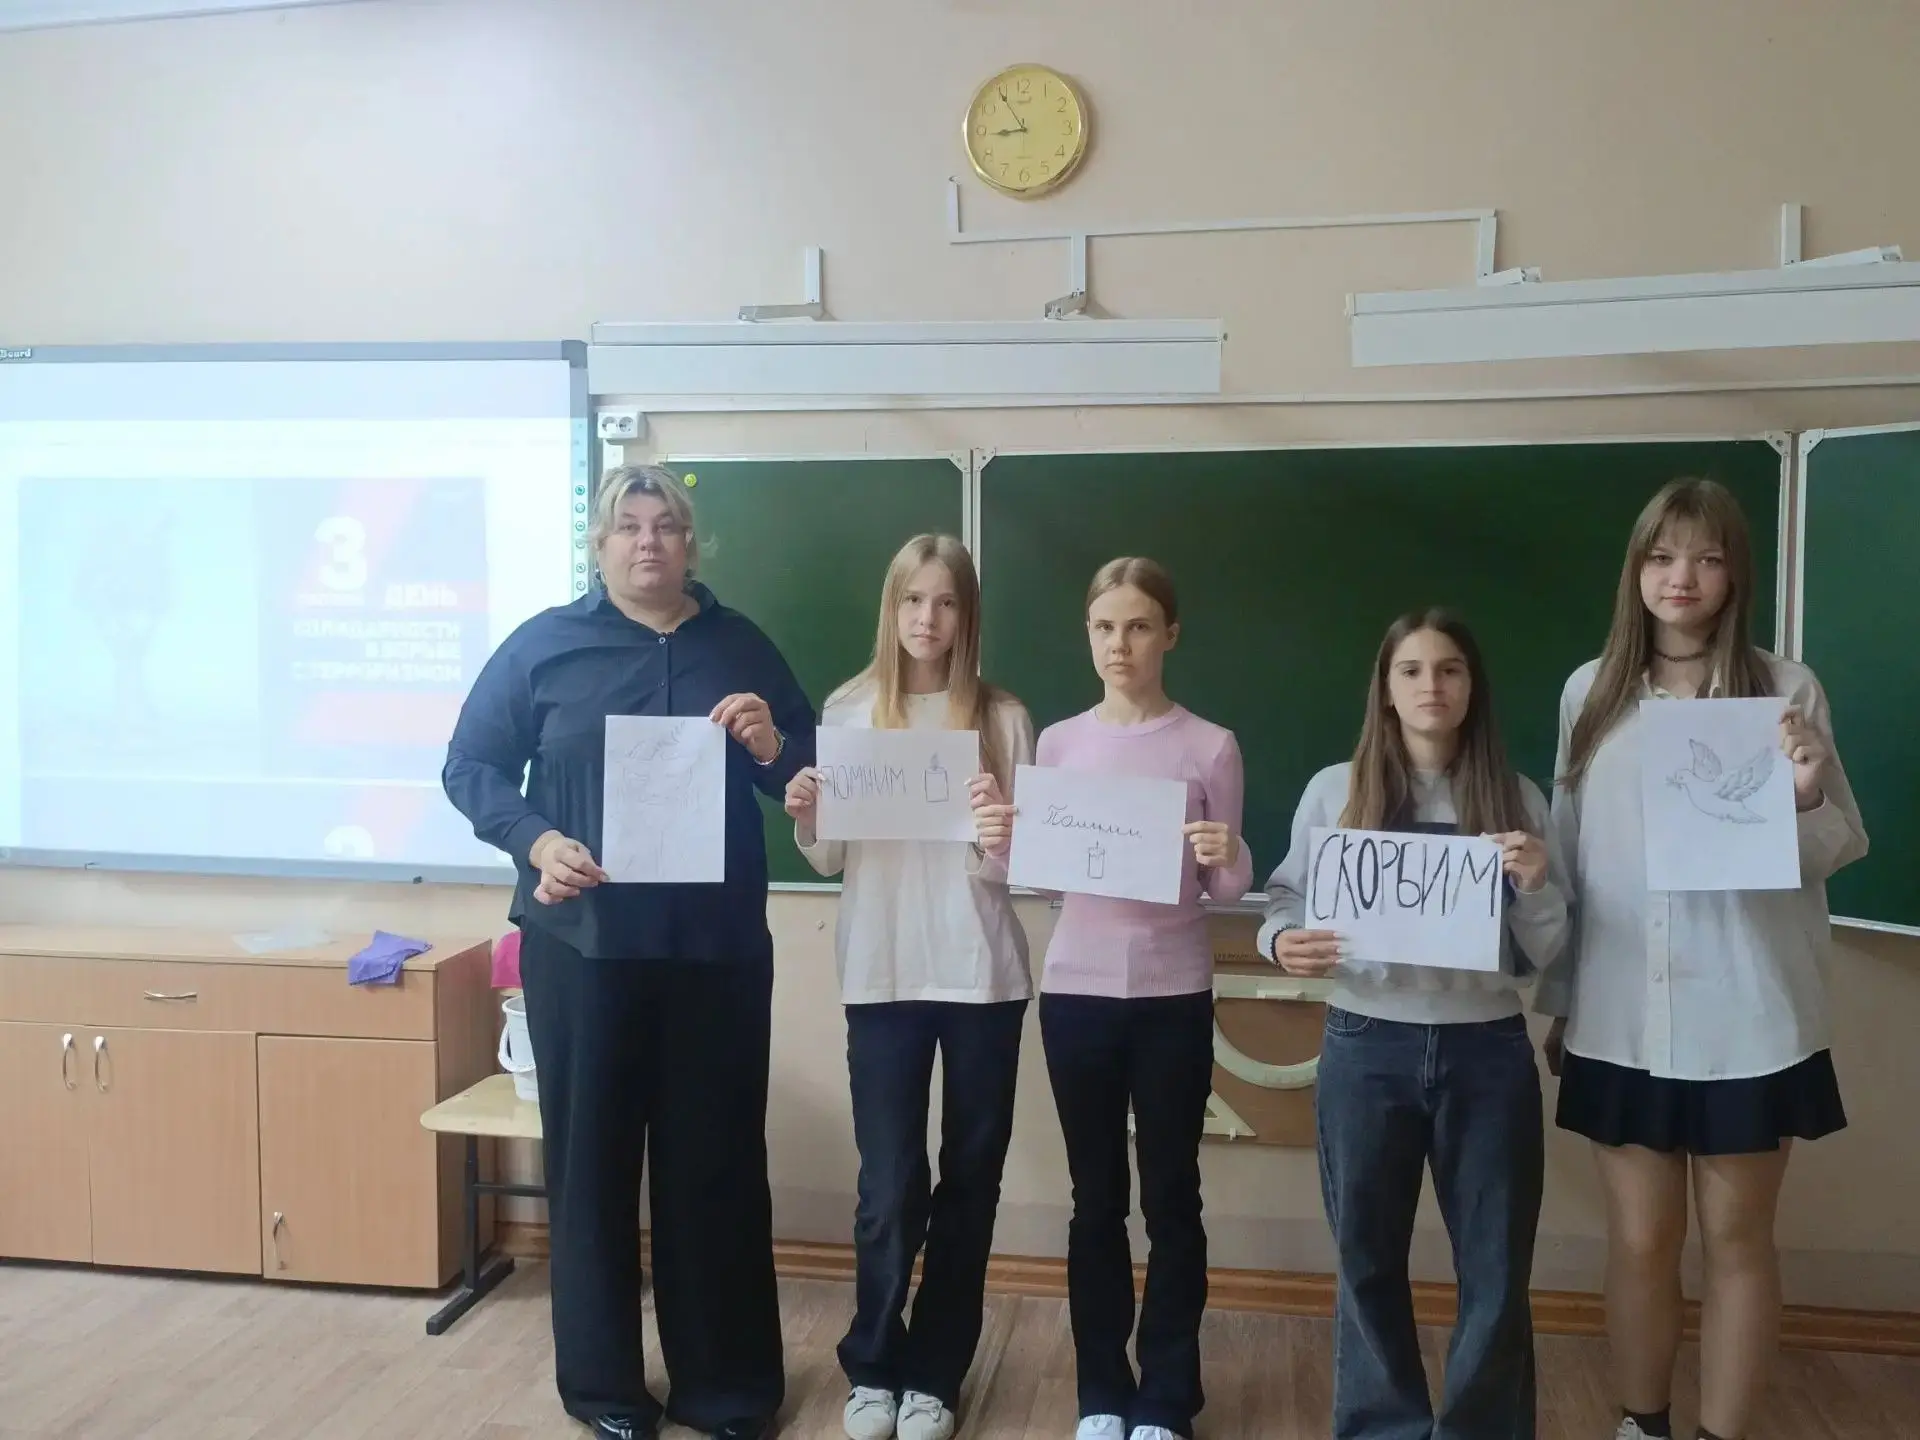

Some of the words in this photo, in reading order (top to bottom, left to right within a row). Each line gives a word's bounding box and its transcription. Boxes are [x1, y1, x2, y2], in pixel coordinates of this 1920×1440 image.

[1017, 79, 1031, 94] 12
[981, 103, 996, 116] 10
[1056, 96, 1067, 113] 2
[976, 125, 987, 137] 9
[1061, 120, 1073, 136] 3
[983, 147, 993, 161] 8
[1054, 144, 1065, 158] 4
[1000, 162, 1009, 176] 7
[1019, 166, 1031, 182] 6
[1040, 161, 1050, 175] 5
[314, 516, 368, 591] 3
[1312, 833, 1498, 921] СКОРБИМ
